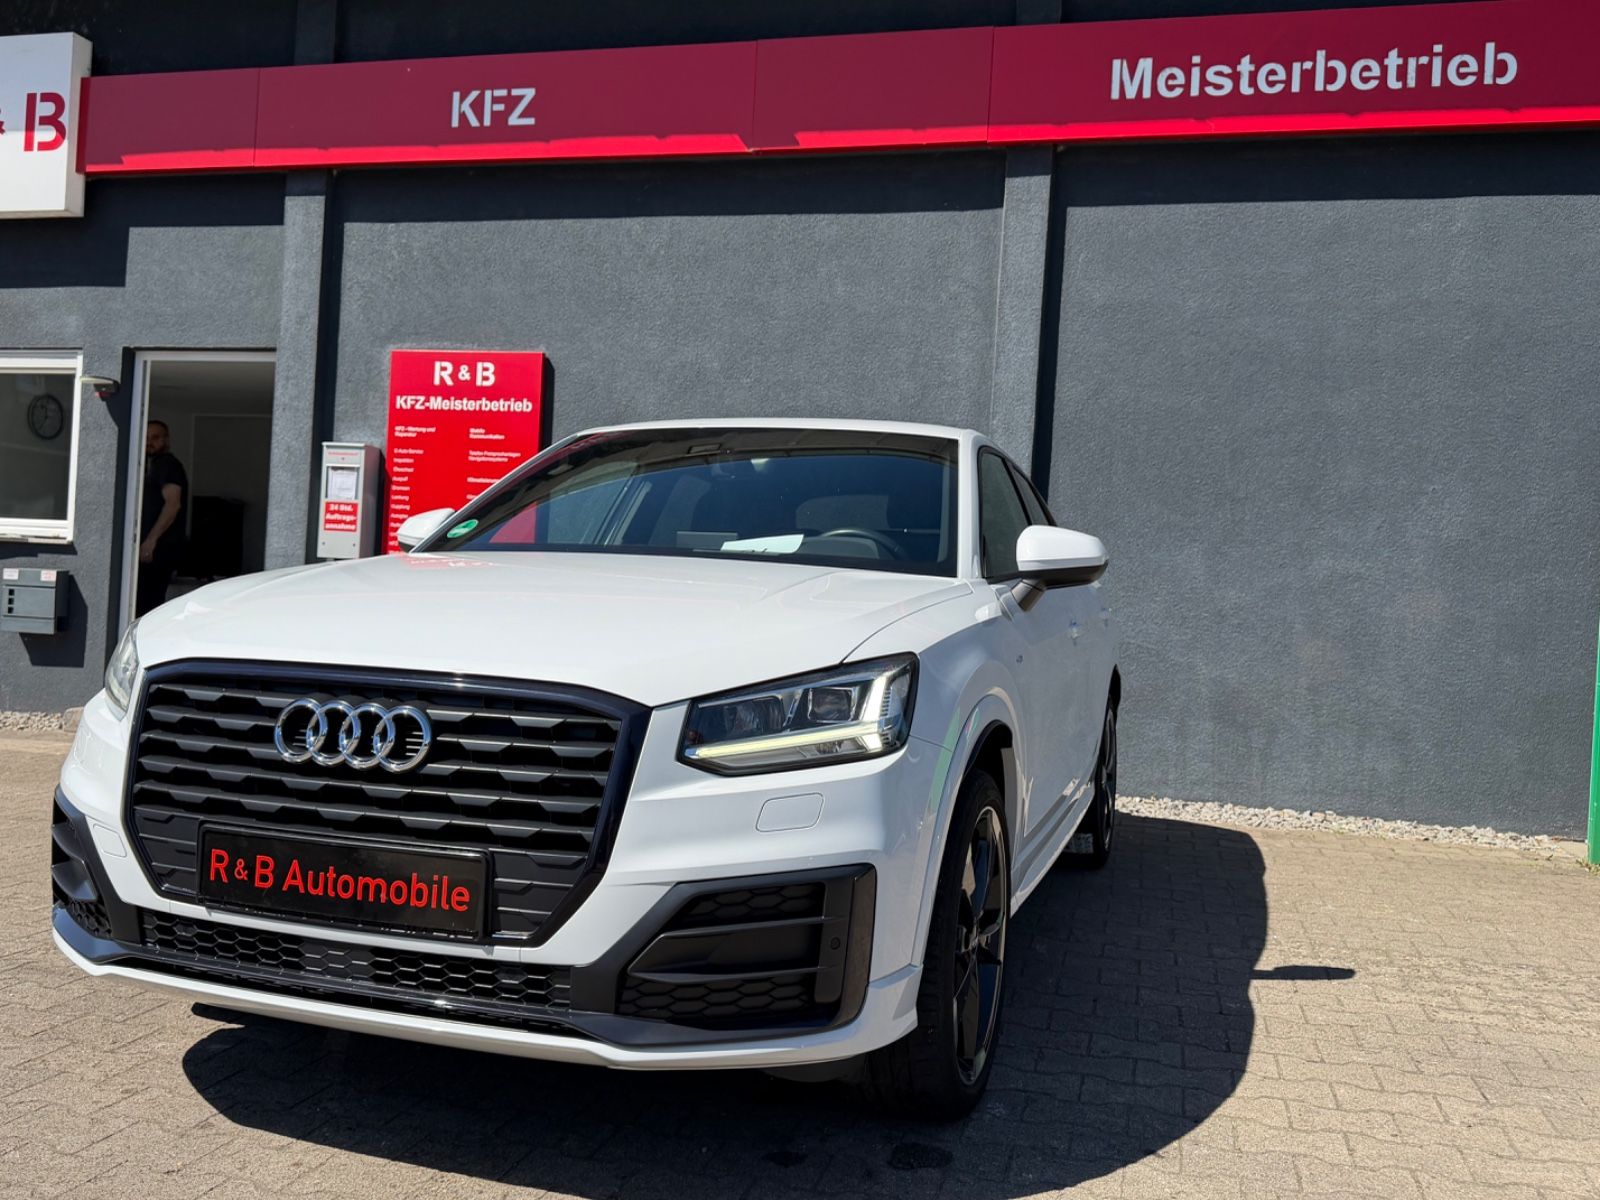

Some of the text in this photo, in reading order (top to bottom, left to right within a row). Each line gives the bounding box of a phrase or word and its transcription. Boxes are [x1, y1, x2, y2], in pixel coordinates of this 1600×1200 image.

[451, 41, 1519, 128] KFZ Meisterbetrieb
[23, 92, 67, 151] B
[433, 360, 496, 387] R & B
[395, 395, 533, 412] KFZ-Meisterbetrieb
[209, 848, 470, 912] R & B Automobile
